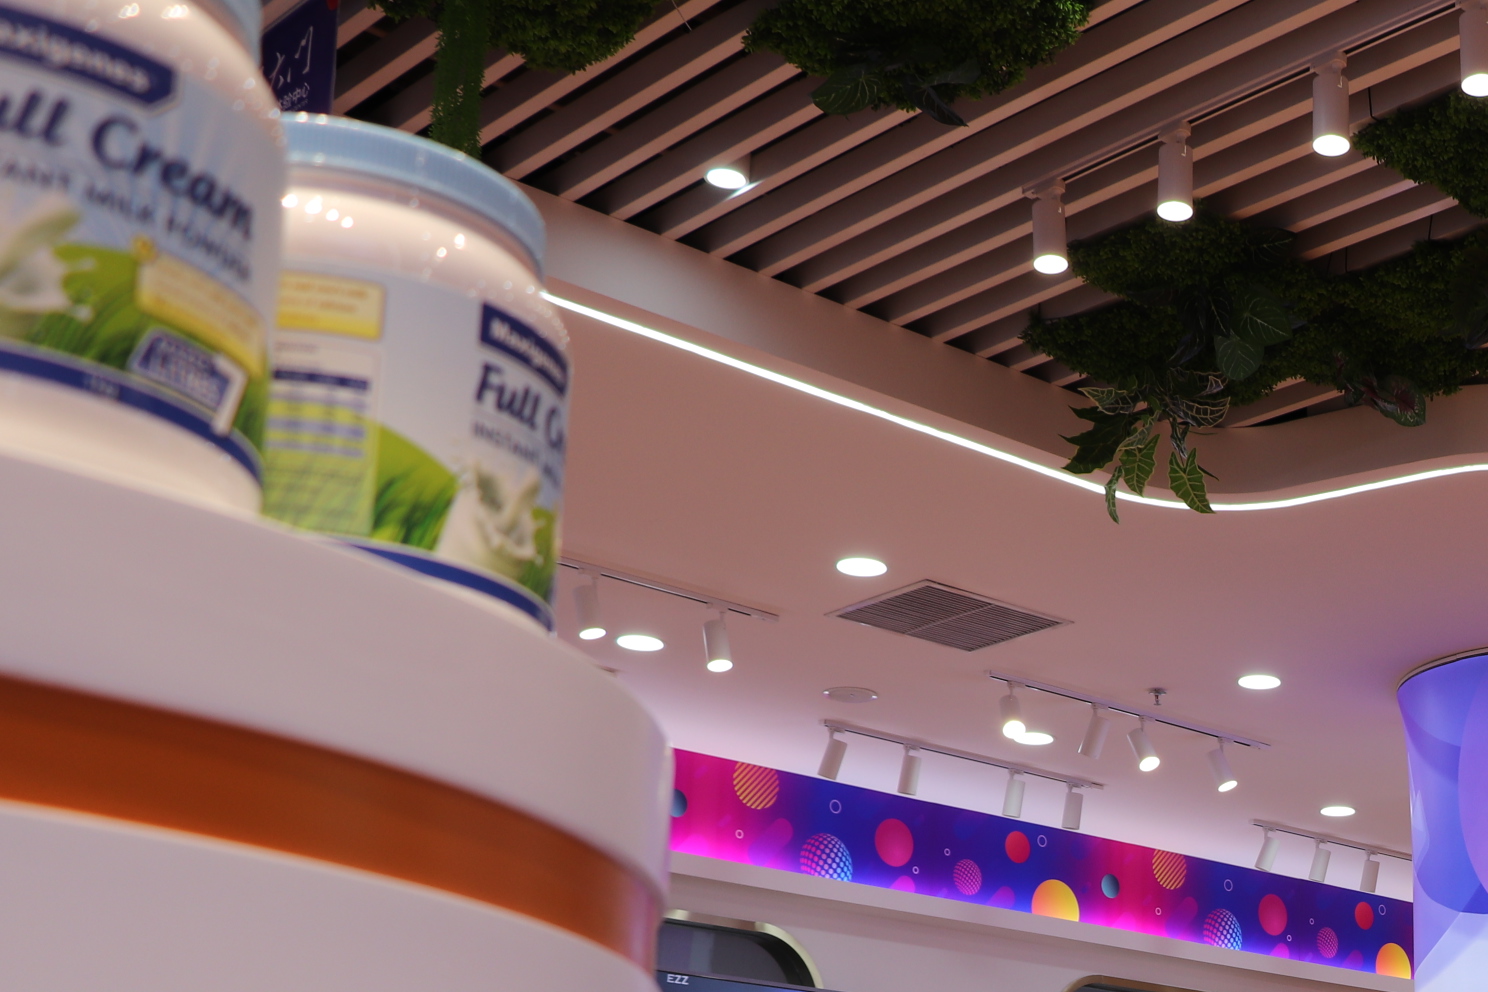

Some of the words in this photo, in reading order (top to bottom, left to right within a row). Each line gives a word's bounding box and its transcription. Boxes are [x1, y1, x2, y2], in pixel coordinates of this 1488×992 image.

[91, 114, 253, 242] Cream
[476, 361, 541, 430] Full
[666, 974, 689, 986] EZZ
